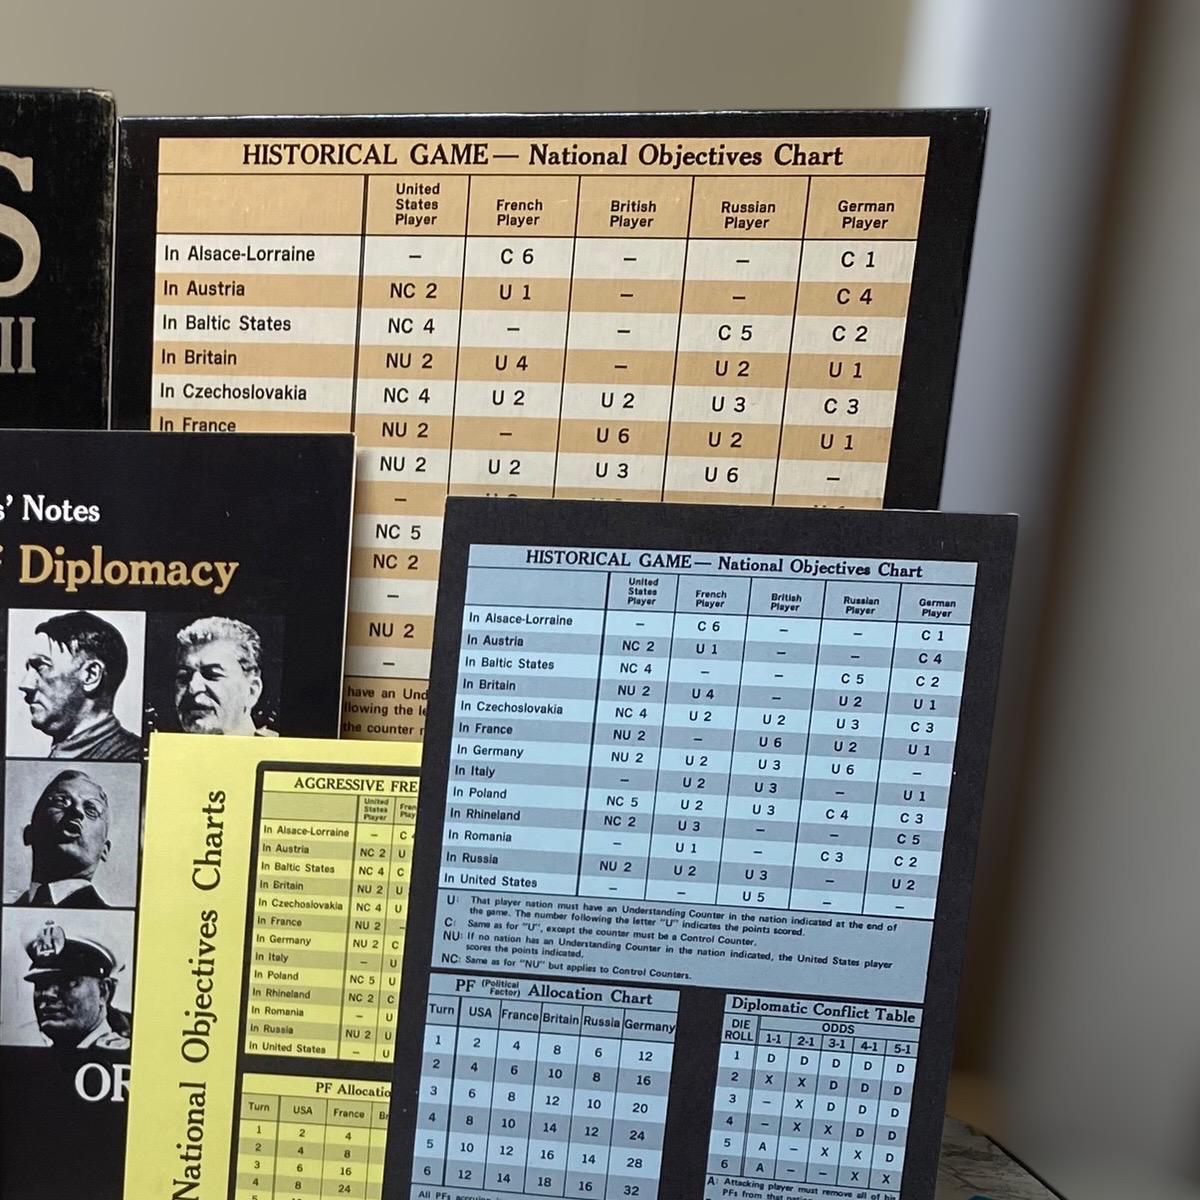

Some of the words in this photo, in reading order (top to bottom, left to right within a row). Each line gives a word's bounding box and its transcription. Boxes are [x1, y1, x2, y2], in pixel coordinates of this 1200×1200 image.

[242, 143, 397, 165] HISTORICAL
[528, 143, 627, 165] National
[638, 143, 762, 169] Objectives
[774, 144, 843, 166] Chart
[396, 182, 440, 195] United
[395, 198, 438, 210] States
[496, 198, 543, 211] French
[610, 200, 656, 212] British
[721, 200, 775, 213] Russian
[838, 199, 894, 212] German
[395, 213, 437, 227] Player
[496, 213, 540, 228] Player
[609, 214, 654, 229] Player
[724, 216, 770, 231] Player
[842, 216, 888, 231] Player
[164, 245, 179, 261] In
[187, 245, 315, 261] Alsace-Lorraine
[164, 279, 178, 296] In
[186, 280, 245, 296] Austria
[163, 314, 177, 330] In
[186, 314, 230, 330] Baltic
[239, 315, 291, 331] States
[161, 348, 176, 364] In
[184, 349, 237, 365] Britain
[160, 382, 174, 398] In
[183, 383, 307, 400] Czechoslovakia
[22, 494, 100, 522] Notes
[18, 544, 239, 594] Diplomacy
[526, 549, 631, 567] HISTORICAL
[717, 556, 783, 572] National
[790, 558, 871, 576] Objectives
[877, 561, 923, 578] Chart
[294, 777, 384, 791] AGGRESSIVE
[391, 780, 418, 794] FRE
[192, 789, 227, 891] Charts
[182, 909, 219, 1064] Objectives
[455, 979, 476, 992] PF
[482, 980, 519, 989] (Political
[490, 988, 520, 997] Factor)
[528, 984, 603, 1001] Allocation
[611, 990, 653, 1005] Chart
[732, 997, 808, 1014] Diplomatic
[813, 1004, 869, 1019] Conflict
[875, 1008, 915, 1023] Table
[429, 1004, 455, 1015] Turn
[469, 1007, 492, 1018] USA
[501, 1009, 539, 1021] France
[543, 1013, 580, 1025] Britain
[583, 1016, 620, 1028] Russia
[624, 1019, 676, 1033] Germany
[732, 1019, 751, 1029] DIE
[822, 1023, 855, 1034] ODDS
[725, 1031, 754, 1042] ROLL
